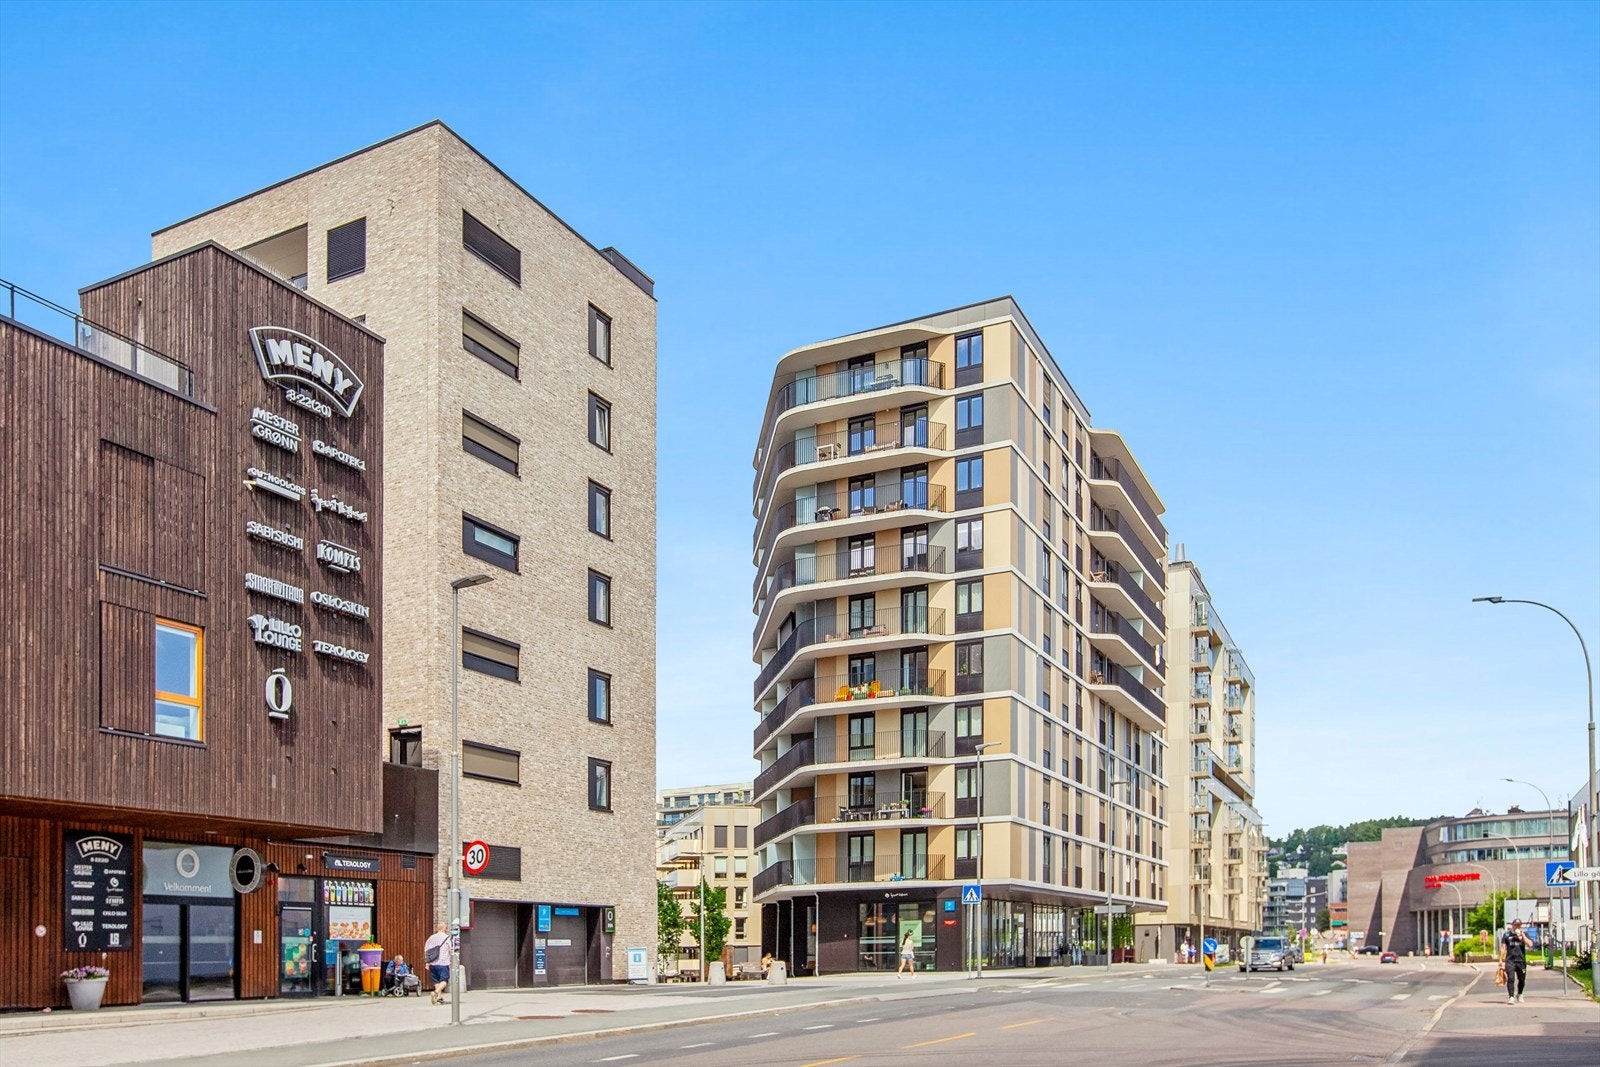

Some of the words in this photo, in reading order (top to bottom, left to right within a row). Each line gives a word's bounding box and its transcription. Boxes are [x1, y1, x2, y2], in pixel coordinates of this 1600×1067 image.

[265, 338, 353, 395] MENY
[252, 407, 299, 436] MESTER
[253, 424, 298, 453] GRØNN
[247, 521, 274, 540] SABI
[274, 530, 303, 550] SUSHI
[310, 591, 342, 609] OSLO
[342, 600, 369, 618] SKIN
[268, 618, 301, 637] LILLO
[255, 631, 301, 652] LOUNGE
[313, 641, 370, 664] TEAOLOGY
[82, 840, 118, 853] MENY
[469, 848, 484, 865] 30
